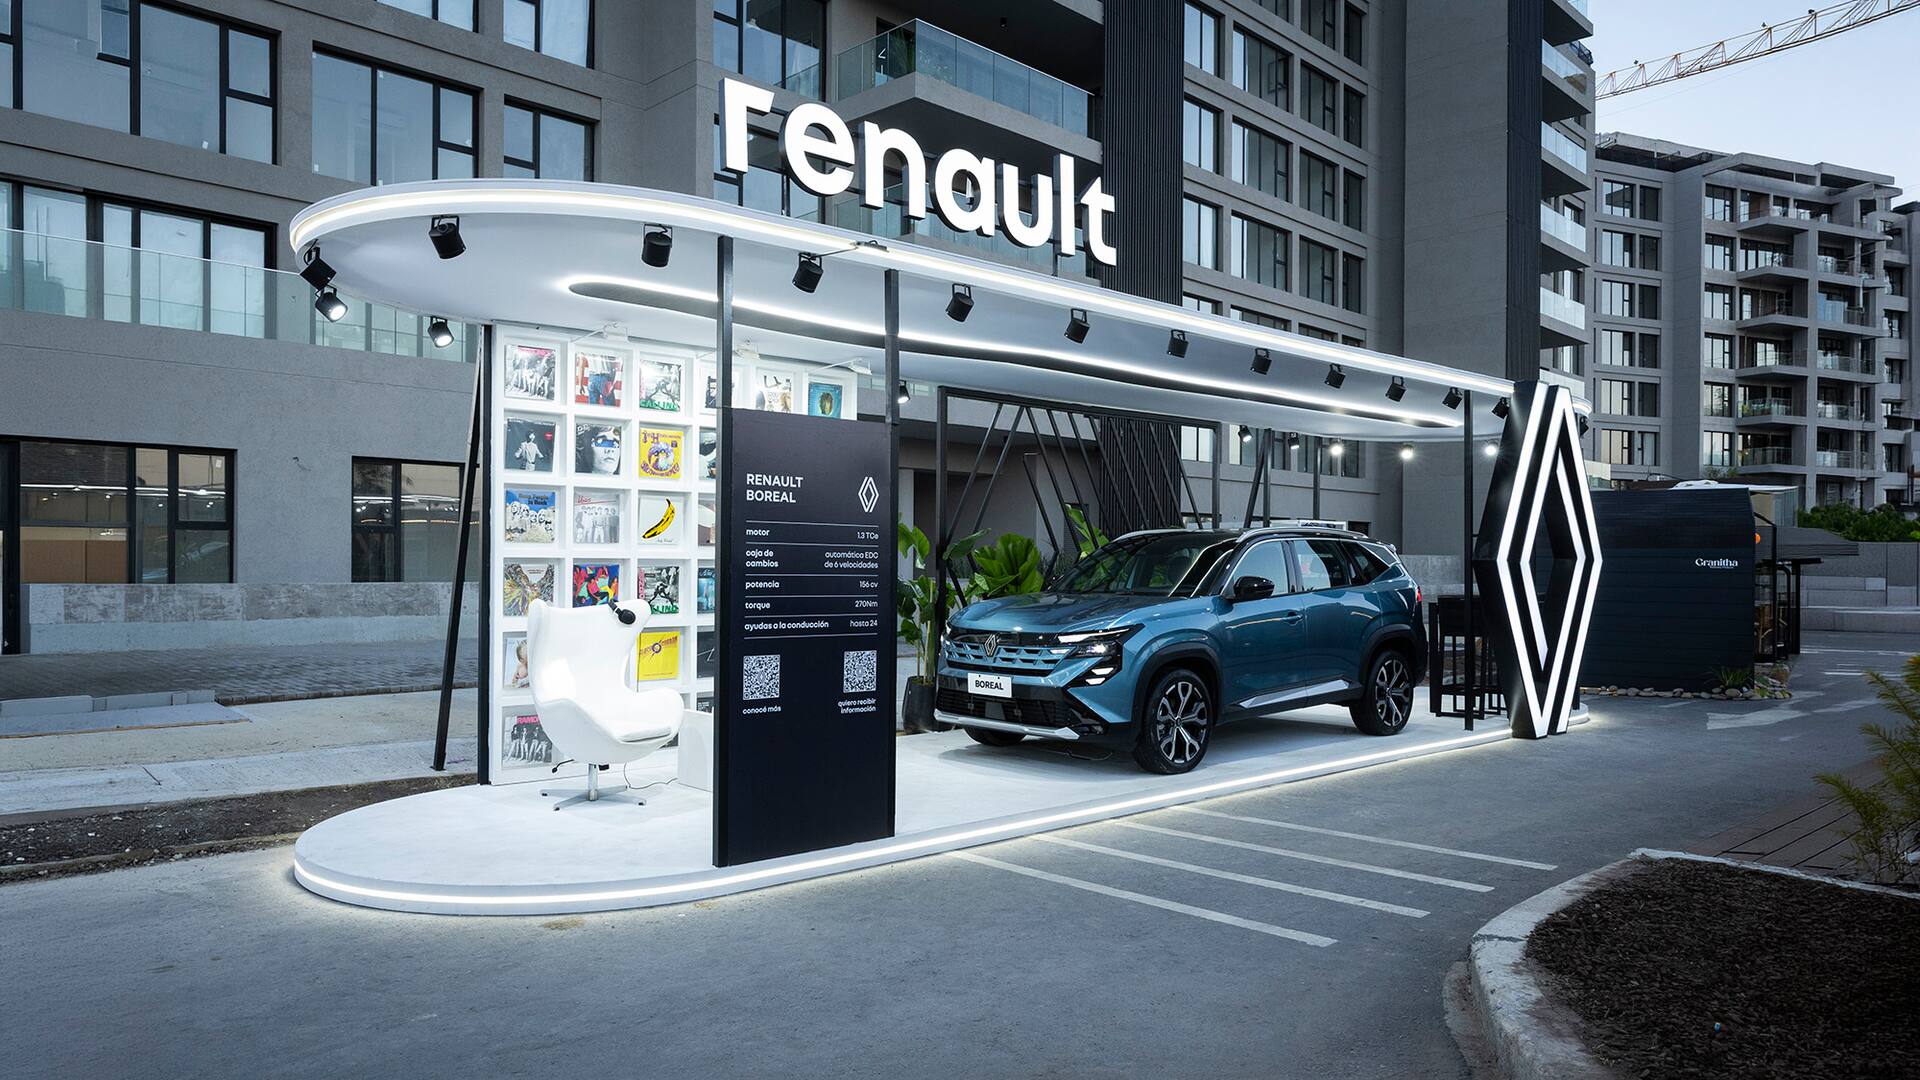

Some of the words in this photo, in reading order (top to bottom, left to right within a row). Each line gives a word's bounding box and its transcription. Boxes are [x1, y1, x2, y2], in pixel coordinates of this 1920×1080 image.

[719, 77, 1117, 266] renault
[746, 473, 804, 488] RENAULT
[746, 489, 797, 503] BOREAL
[865, 531, 879, 540] TCe
[746, 549, 763, 558] caja
[763, 549, 774, 557] de
[824, 550, 864, 559] automática
[865, 551, 879, 559] EDC
[745, 559, 779, 568] cambios
[823, 560, 834, 568] de
[839, 560, 879, 569] velocidades
[745, 580, 780, 590] potencia
[744, 602, 771, 611] torque
[854, 600, 879, 608] 270Nm
[744, 622, 772, 631] ayudas
[779, 621, 786, 629] la
[787, 620, 829, 629] conducción
[849, 619, 870, 628] hasta
[870, 619, 878, 627] 24
[975, 680, 1004, 690] BOREAL
